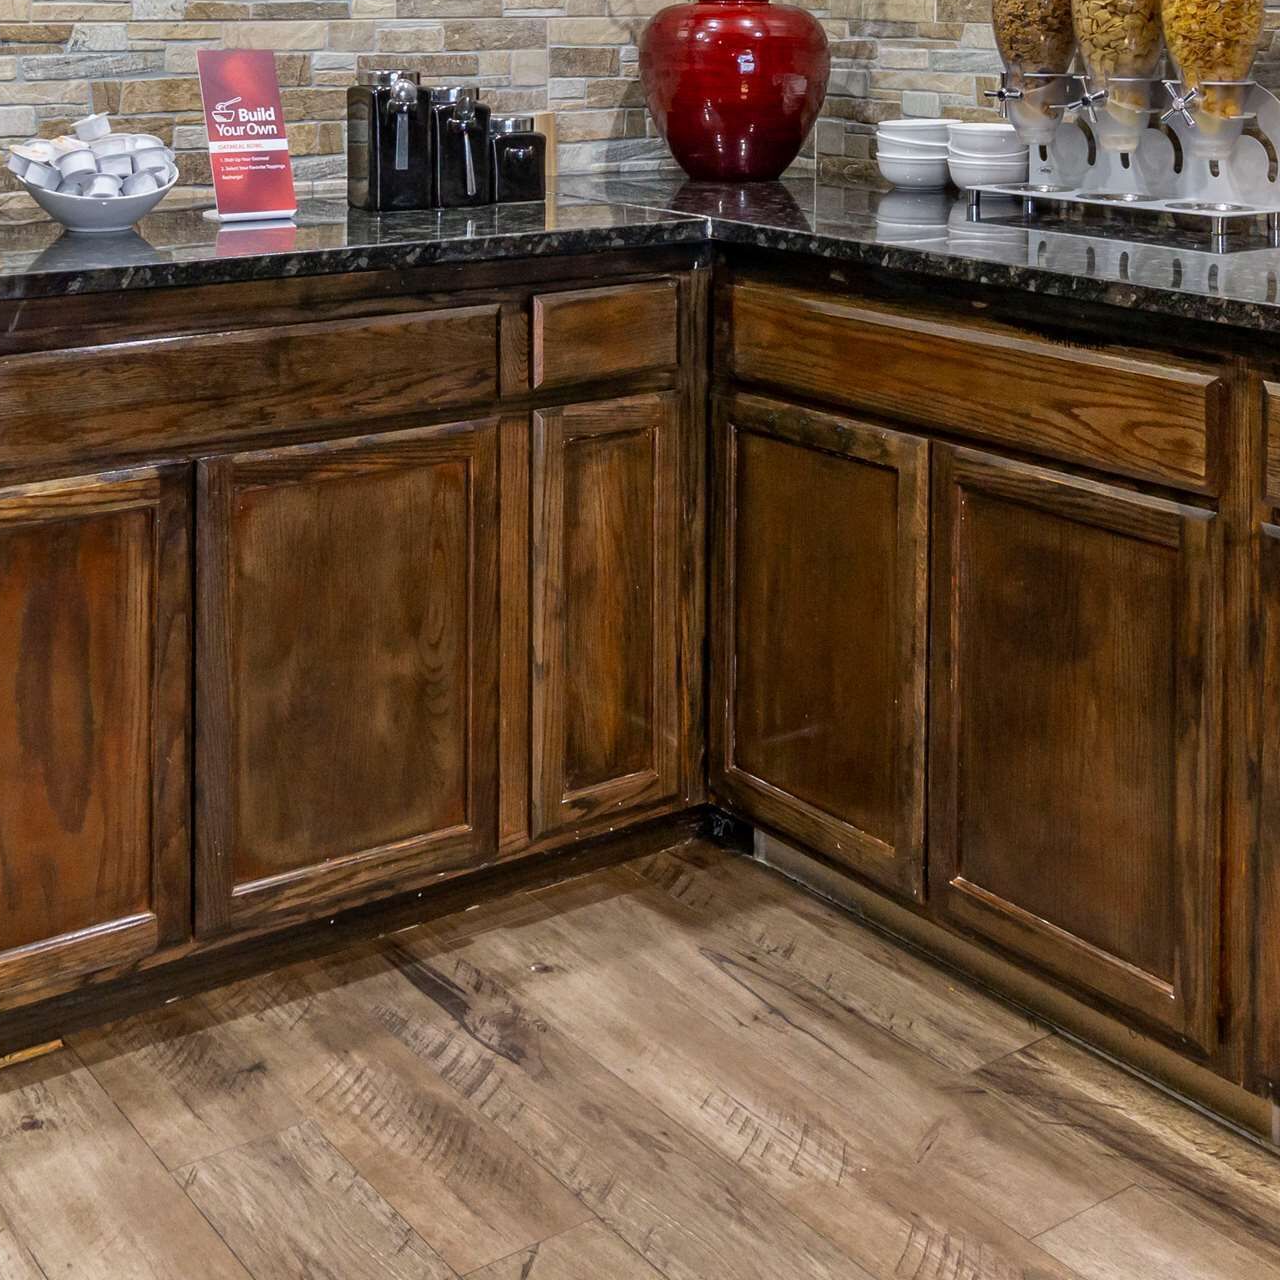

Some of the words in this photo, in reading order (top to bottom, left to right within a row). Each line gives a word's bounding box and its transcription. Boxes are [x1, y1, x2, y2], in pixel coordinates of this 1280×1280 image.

[238, 107, 275, 121] Build
[215, 123, 245, 136] Your
[246, 122, 277, 135] Own
